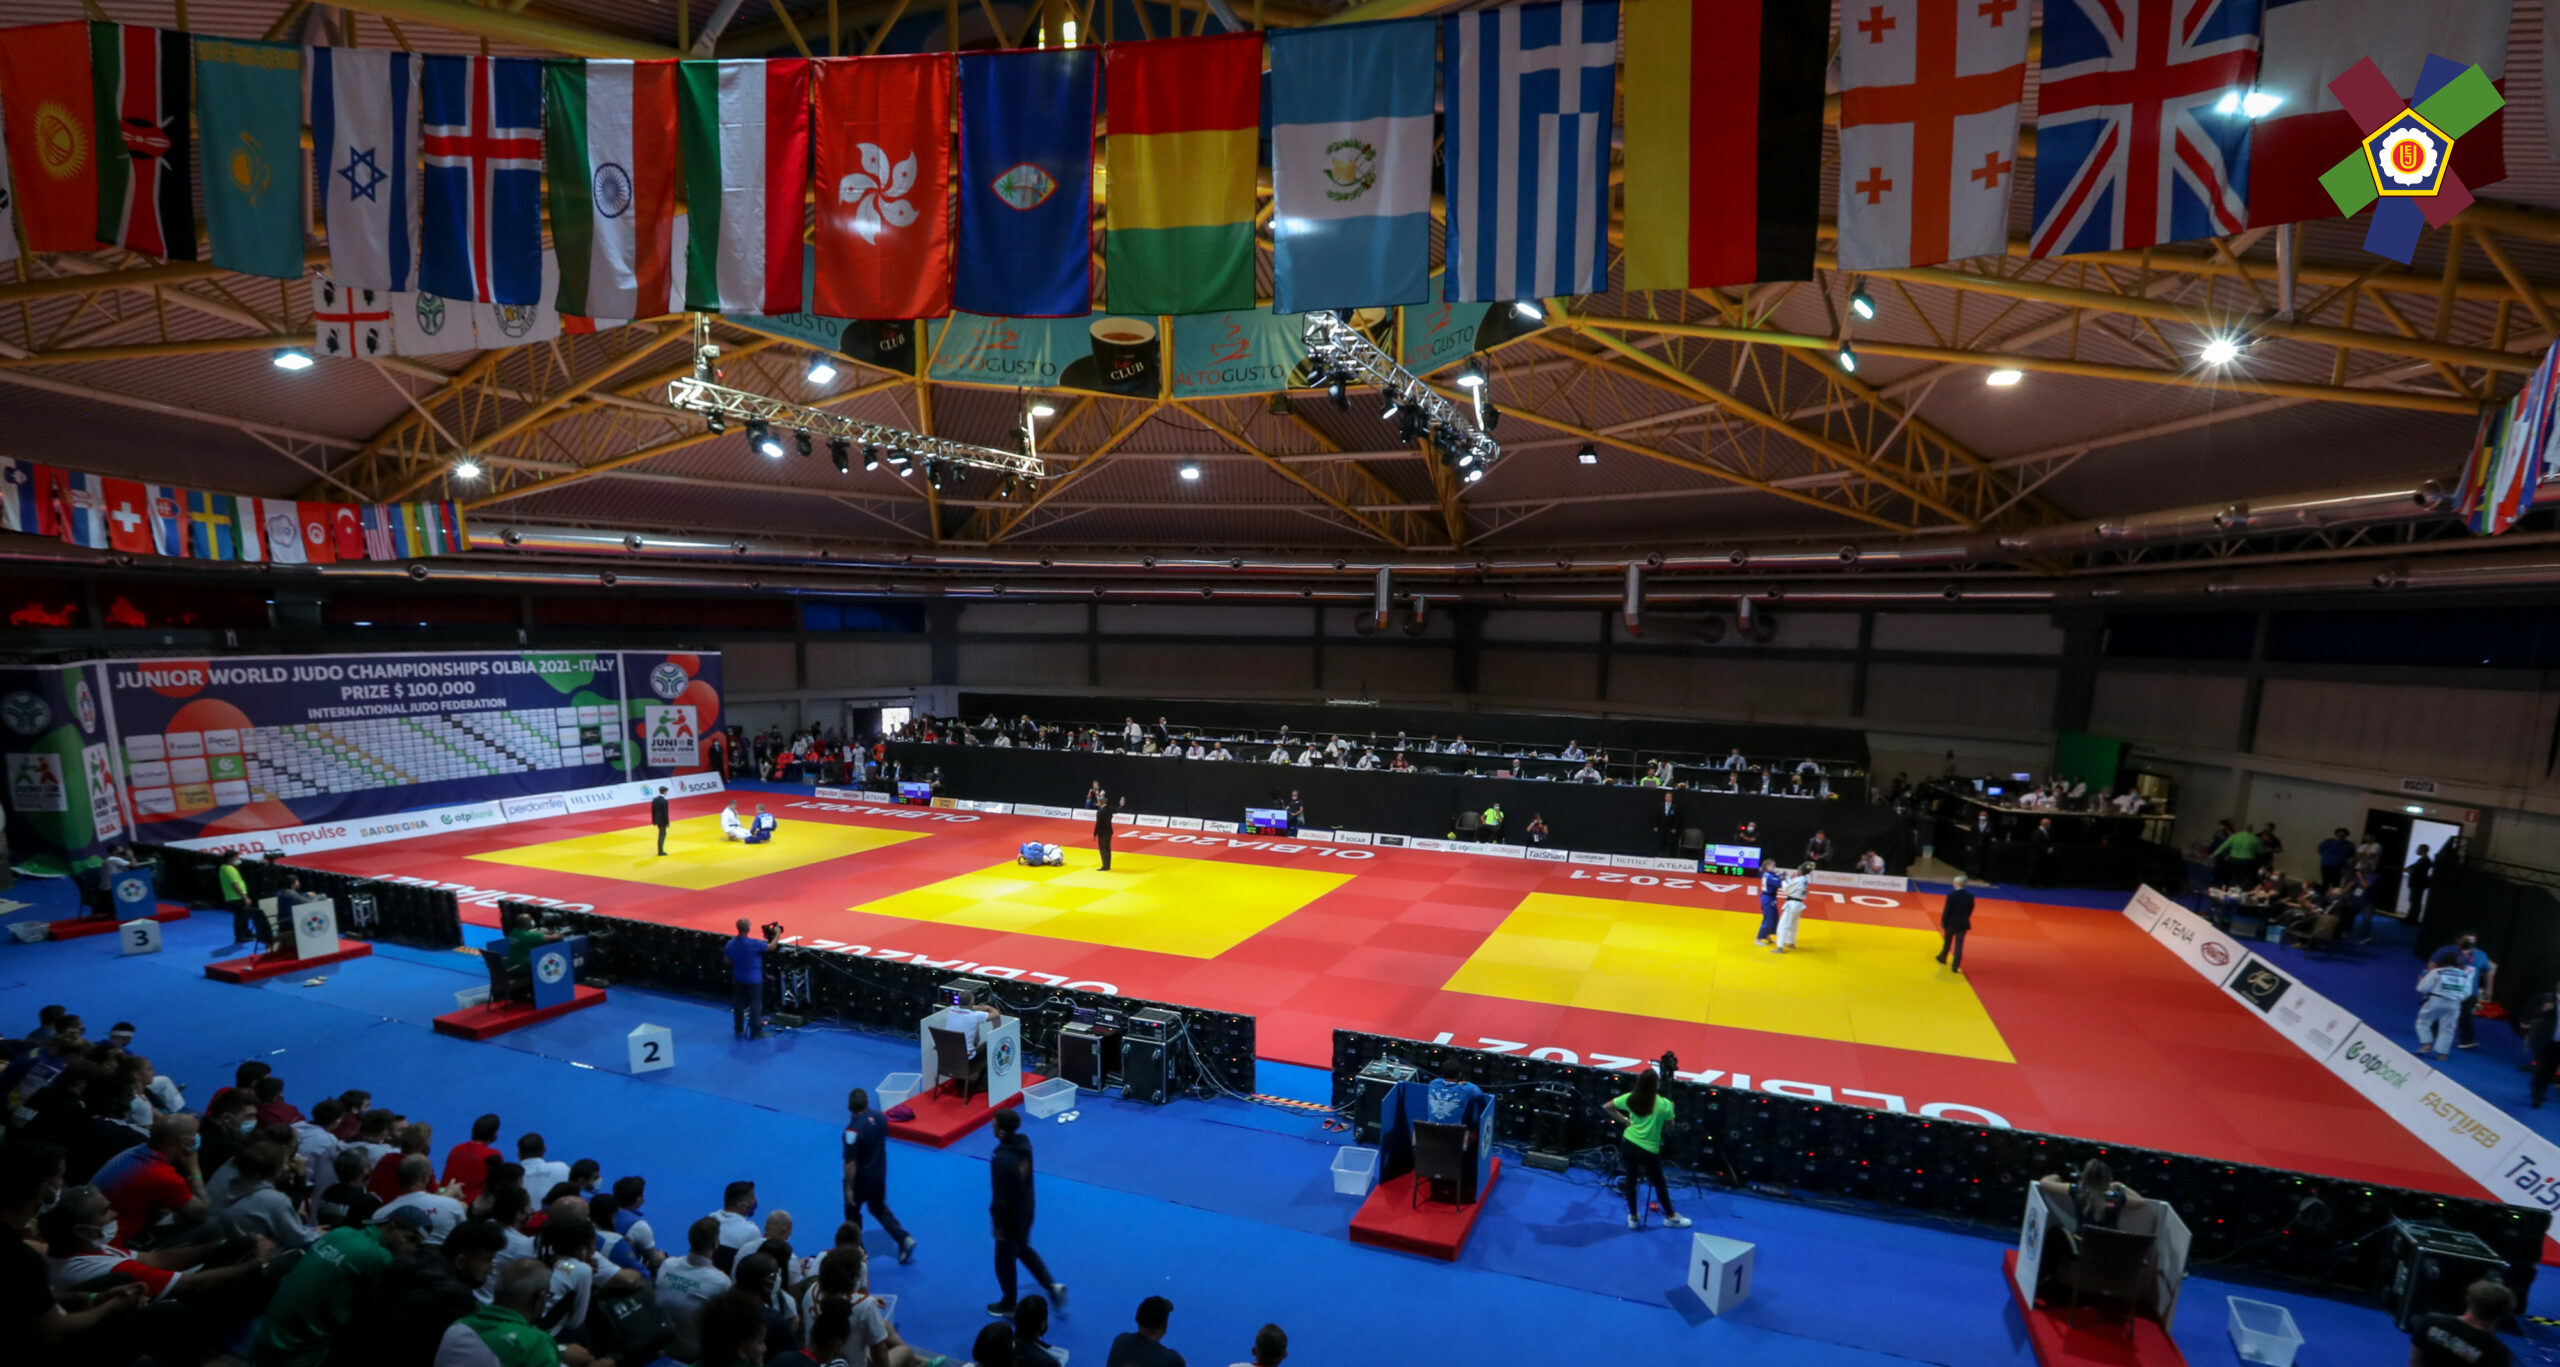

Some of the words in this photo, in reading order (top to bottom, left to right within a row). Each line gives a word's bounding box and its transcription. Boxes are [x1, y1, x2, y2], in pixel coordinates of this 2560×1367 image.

[880, 334, 905, 351] CLUB
[1110, 361, 1144, 380] CLUB
[116, 669, 204, 689] JUNIOR
[206, 667, 288, 685] WORLD
[291, 665, 344, 682] JUDO
[347, 660, 489, 680] CHAMPIONSHIPS
[492, 660, 537, 674] OLBIA
[341, 683, 390, 701] PRIZE
[394, 683, 403, 700] $
[407, 681, 476, 699] 100,000
[308, 703, 407, 720] INTERNATIONAL
[409, 702, 438, 713] JUDO
[441, 698, 507, 711] FEDERATION
[688, 781, 718, 793] SOCAR
[785, 801, 980, 823] OLBIA2021
[277, 825, 347, 846] impulse
[360, 820, 429, 838] SARDEGNA
[1117, 830, 1375, 860] OLBIA2021
[1529, 850, 1565, 860] TaiShan
[1657, 862, 1695, 870] ATENA
[133, 930, 149, 946] 3
[2161, 917, 2197, 944] ATENA
[643, 1041, 661, 1063] 2
[2359, 1051, 2411, 1091] otpbank
[2420, 1091, 2501, 1149] FASTWEB
[1702, 1259, 1709, 1291] 1
[1734, 1265, 1743, 1294] 1
